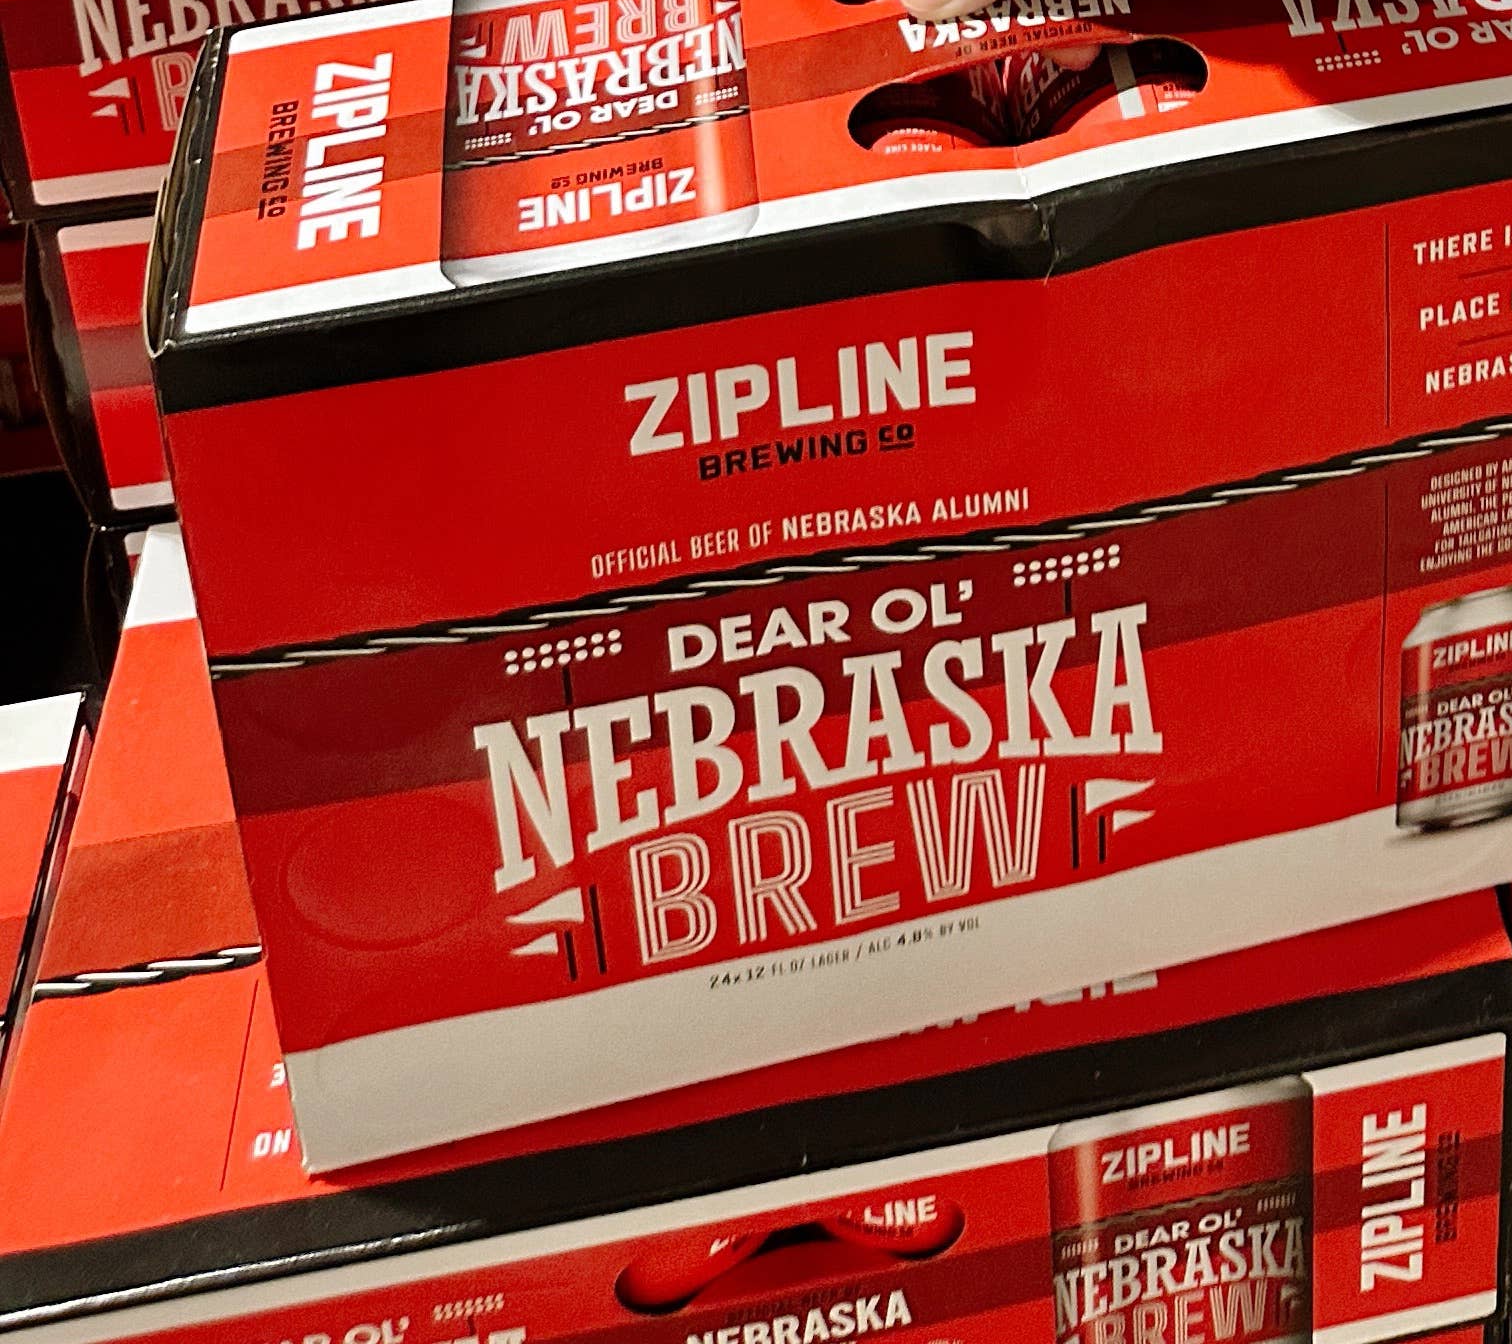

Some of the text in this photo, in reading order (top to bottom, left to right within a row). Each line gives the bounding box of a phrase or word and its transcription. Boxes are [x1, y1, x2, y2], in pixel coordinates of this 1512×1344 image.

[453, 14, 747, 126] NEBRASKA
[591, 91, 679, 124] DEAR
[261, 100, 299, 194] BREWING
[297, 52, 394, 251] ZIPLINE
[518, 165, 697, 234] ZIPLINE
[1413, 227, 1493, 265] THERE
[1420, 292, 1500, 331] PLACE
[625, 330, 976, 456] ZIPLINE
[698, 429, 868, 482] BREWING
[591, 486, 1030, 579] OFFICIAL BEER OF NEBRASKA ALUMNI
[668, 579, 974, 673] DEAR OL'
[473, 602, 1164, 894] NEBRASKA
[628, 762, 1046, 966] BREW
[1101, 1122, 1251, 1185] ZIPLINE
[1361, 1102, 1427, 1293] ZIPLINE
[1113, 1223, 1189, 1255] DEAR
